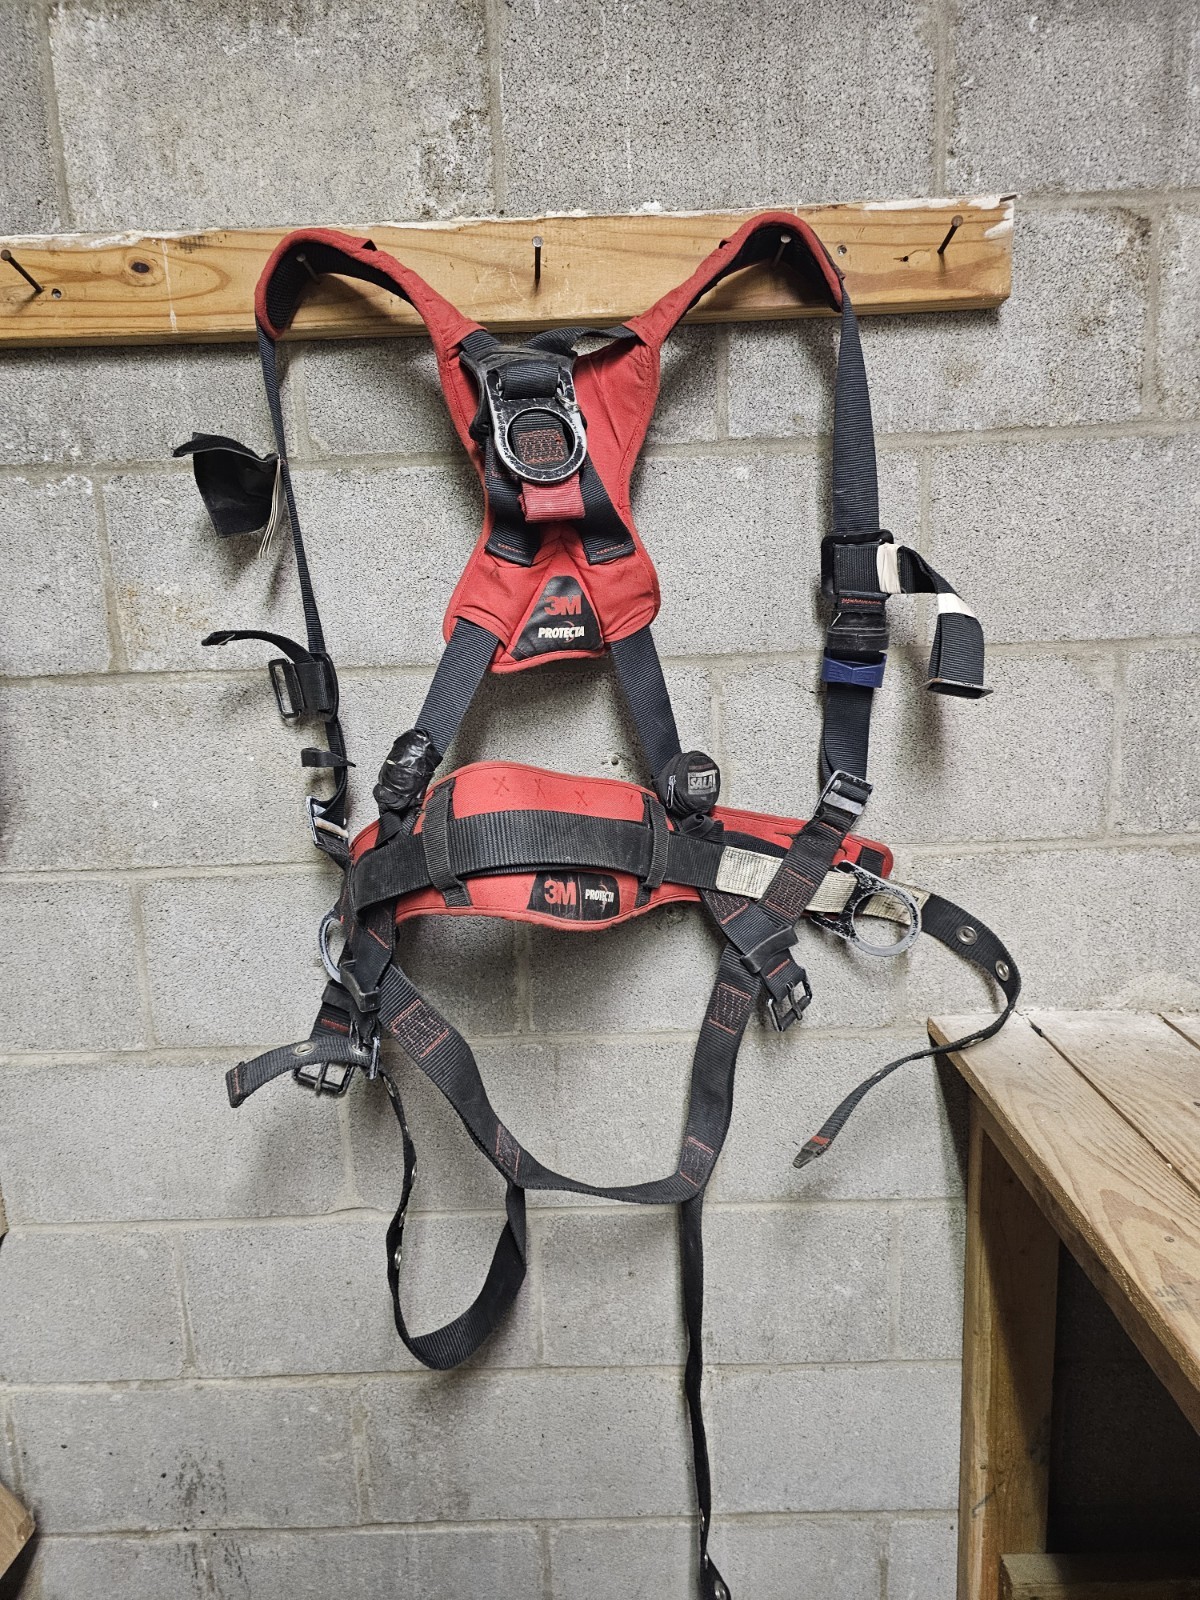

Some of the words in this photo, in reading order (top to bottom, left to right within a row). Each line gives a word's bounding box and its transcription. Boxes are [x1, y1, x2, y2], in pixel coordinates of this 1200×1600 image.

[544, 594, 581, 615] 3M
[538, 626, 585, 639] PROTECTA
[544, 880, 576, 905] 3M
